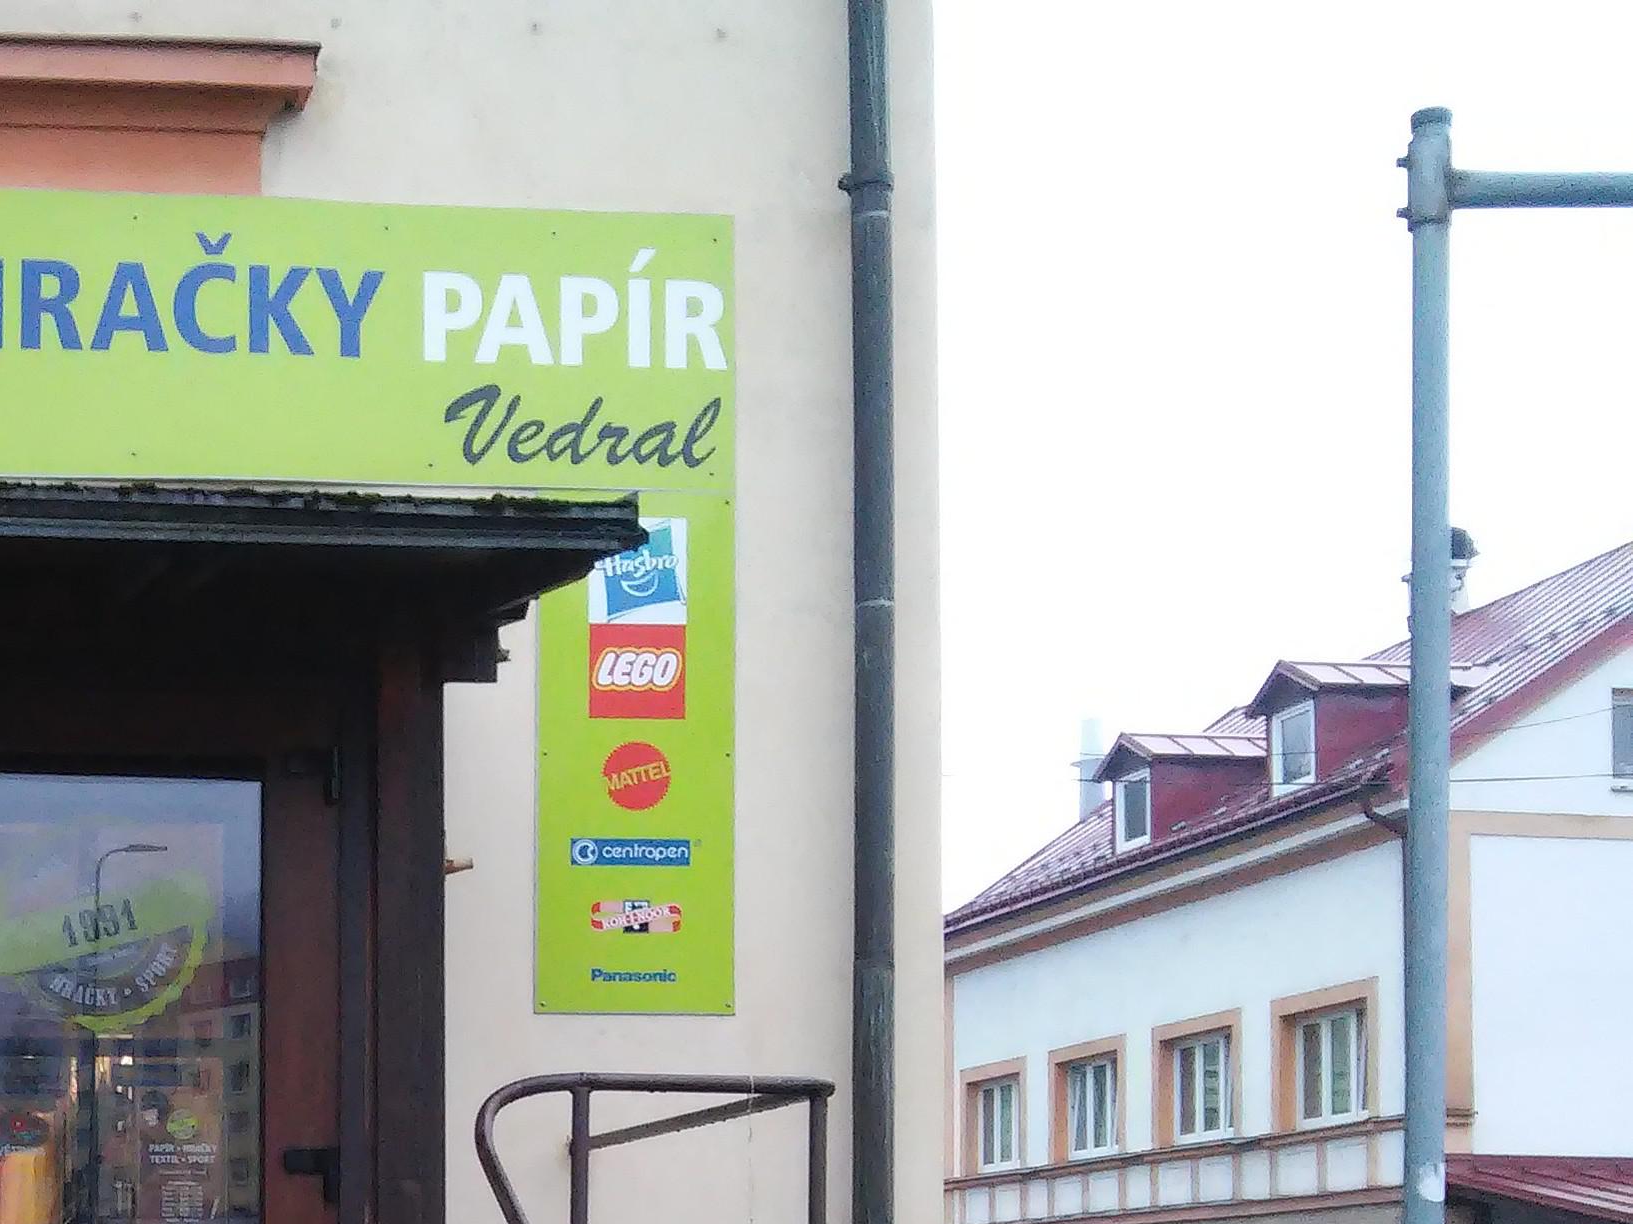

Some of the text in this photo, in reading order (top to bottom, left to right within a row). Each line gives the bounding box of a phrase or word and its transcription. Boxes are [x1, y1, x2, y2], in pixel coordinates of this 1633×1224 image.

[423, 247, 728, 370] PAPÍR
[444, 384, 722, 469] Vedral
[594, 550, 679, 578] Hasbro
[596, 650, 677, 687] LEGO
[606, 760, 671, 791] MATTEL
[602, 844, 689, 861] centropen
[62, 898, 138, 948] 1991
[591, 967, 677, 983] Panasonic
